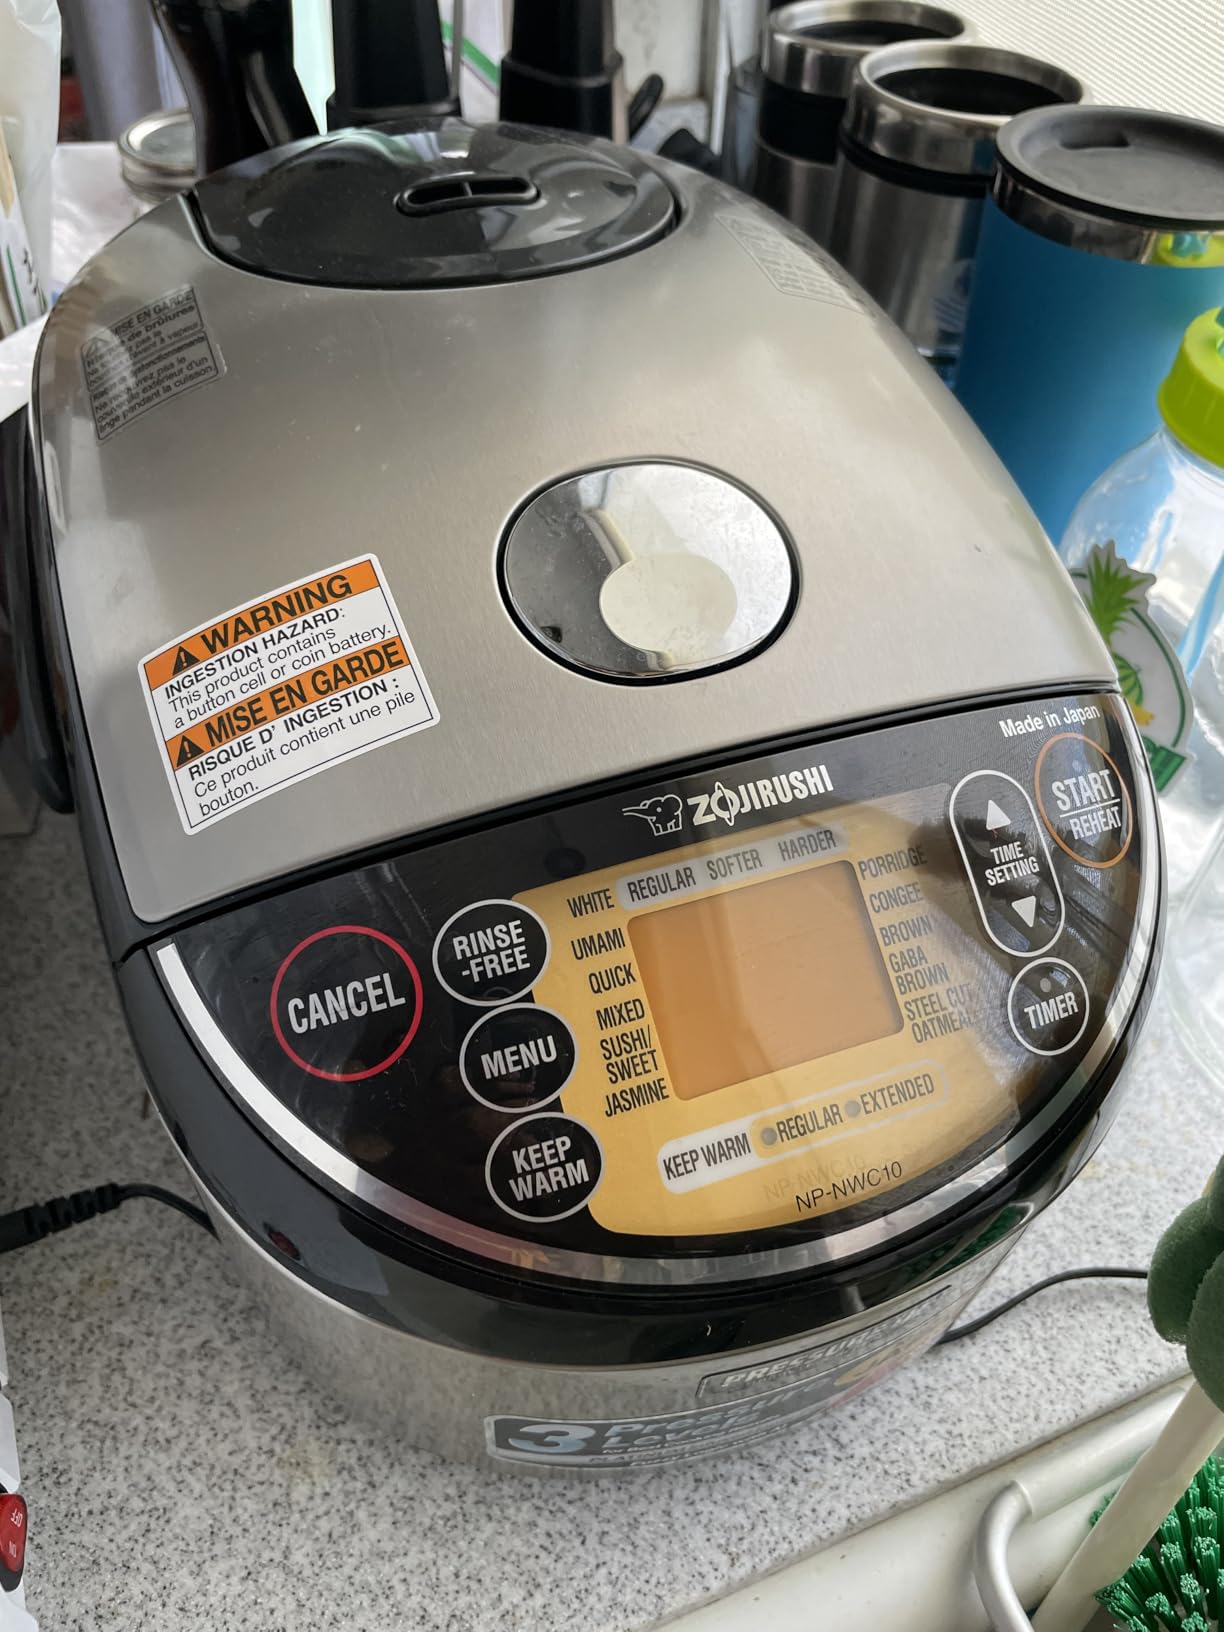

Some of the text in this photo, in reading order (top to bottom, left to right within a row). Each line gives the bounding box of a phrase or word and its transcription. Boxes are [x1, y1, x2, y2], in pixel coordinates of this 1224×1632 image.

[137, 308, 152, 324] EN
[153, 293, 194, 315] GARDE
[201, 574, 353, 654] WARNING
[165, 607, 346, 700] INGESTION HAZARD:
[168, 628, 337, 714] This product contains
[174, 622, 392, 729] a button cell or coin battery.
[204, 640, 404, 748] MISE EN GARDE
[187, 735, 257, 781] RISQUE
[284, 679, 389, 733] INGESTION
[999, 704, 1101, 738] Made in Japan
[194, 690, 416, 798] Ce produit contient une pile
[200, 781, 259, 817] bouton.
[687, 764, 834, 827] ZOJIRUSHI
[1051, 769, 1116, 811] START
[1069, 806, 1122, 840] REHEAT
[627, 829, 837, 903] REGULAR SOFTER HARDER
[858, 846, 928, 881] PORRIDGE
[984, 856, 1040, 887] SETTING
[990, 841, 1024, 865] TIME
[566, 888, 615, 919] WHITE
[869, 882, 924, 914] CONGEE
[452, 919, 526, 961] RINSE
[570, 927, 626, 961] UMAMI
[879, 915, 934, 947] BROWN
[461, 946, 531, 983] -FREE
[888, 945, 929, 974] GABA
[588, 962, 636, 995] QUICK
[895, 962, 950, 996] BROWN
[287, 972, 406, 1034] CANCEL
[596, 998, 645, 1031] MIXED
[904, 983, 974, 1022] STEEL CUT
[1024, 991, 1079, 1029] TIMER
[599, 1024, 652, 1061] SUSHI/
[911, 1011, 974, 1044] OATMEAL
[480, 1035, 558, 1080] MENU
[605, 1049, 659, 1085] SWEET
[604, 1078, 670, 1118] JASMINE
[663, 1073, 935, 1181] KEEP WARM REGULAR EXTENDED
[511, 1135, 572, 1175] KEEP
[508, 1159, 590, 1202] WARM
[795, 1160, 903, 1213] NP-NWC10
[508, 1424, 597, 1454] 3
